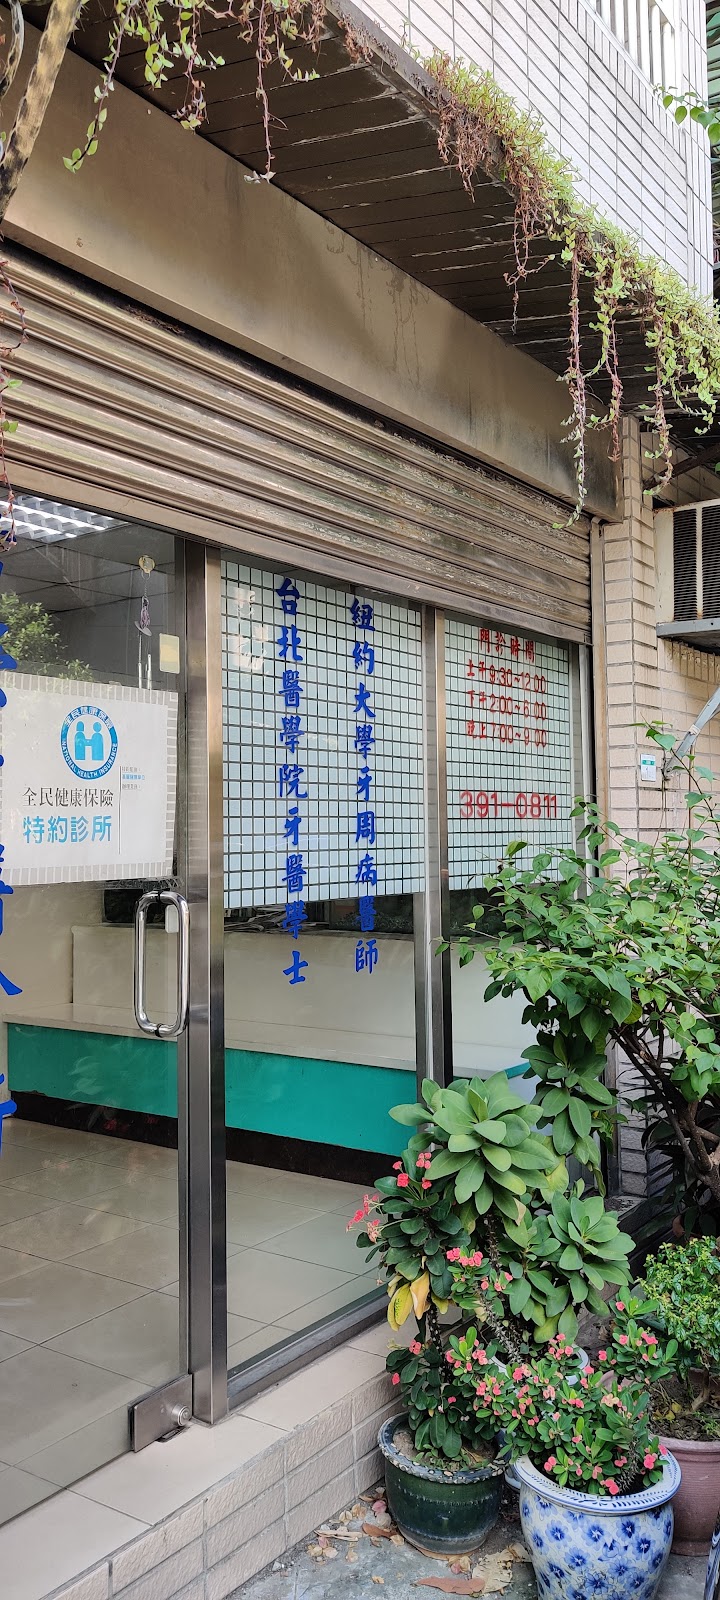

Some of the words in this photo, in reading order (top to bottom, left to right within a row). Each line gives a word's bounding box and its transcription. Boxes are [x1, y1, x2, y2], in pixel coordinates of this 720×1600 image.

[61, 738, 78, 772] NATIONAL
[77, 769, 98, 779] HEALTH
[98, 742, 118, 775] INSURANCE
[23, 787, 114, 808] 全民健康保險
[276, 578, 309, 985] 台北醫學院牙醫學士
[350, 599, 379, 974] 紐約大學牙周病醫師
[460, 790, 557, 819] 391-0811
[23, 815, 112, 844] 特約診所
